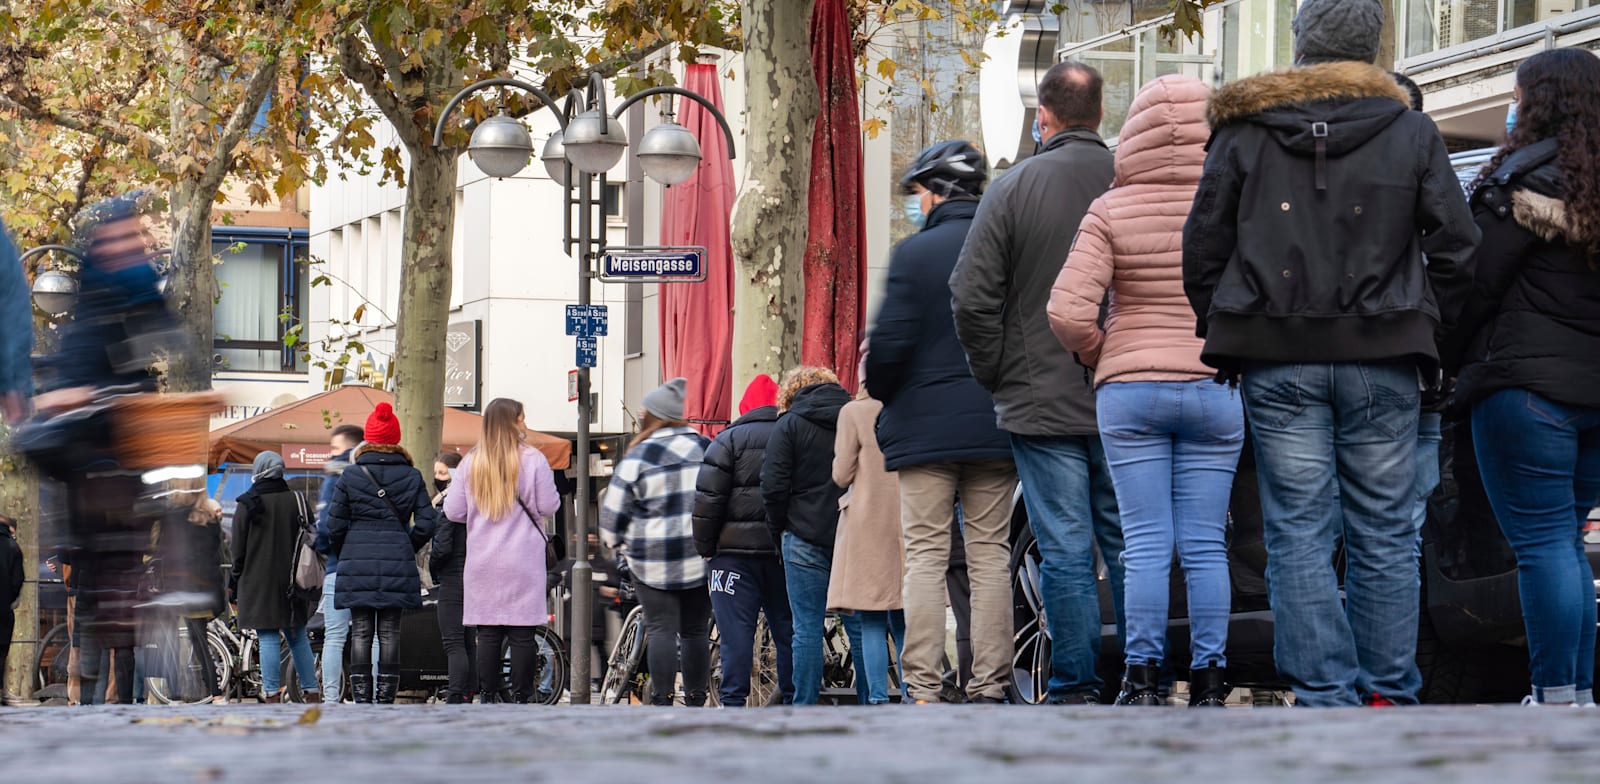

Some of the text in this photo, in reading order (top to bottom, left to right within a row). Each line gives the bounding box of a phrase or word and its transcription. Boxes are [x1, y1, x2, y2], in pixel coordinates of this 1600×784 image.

[611, 256, 693, 274] Meisengasse
[446, 367, 472, 380] lier
[445, 386, 463, 395] er
[710, 570, 741, 595] KE
